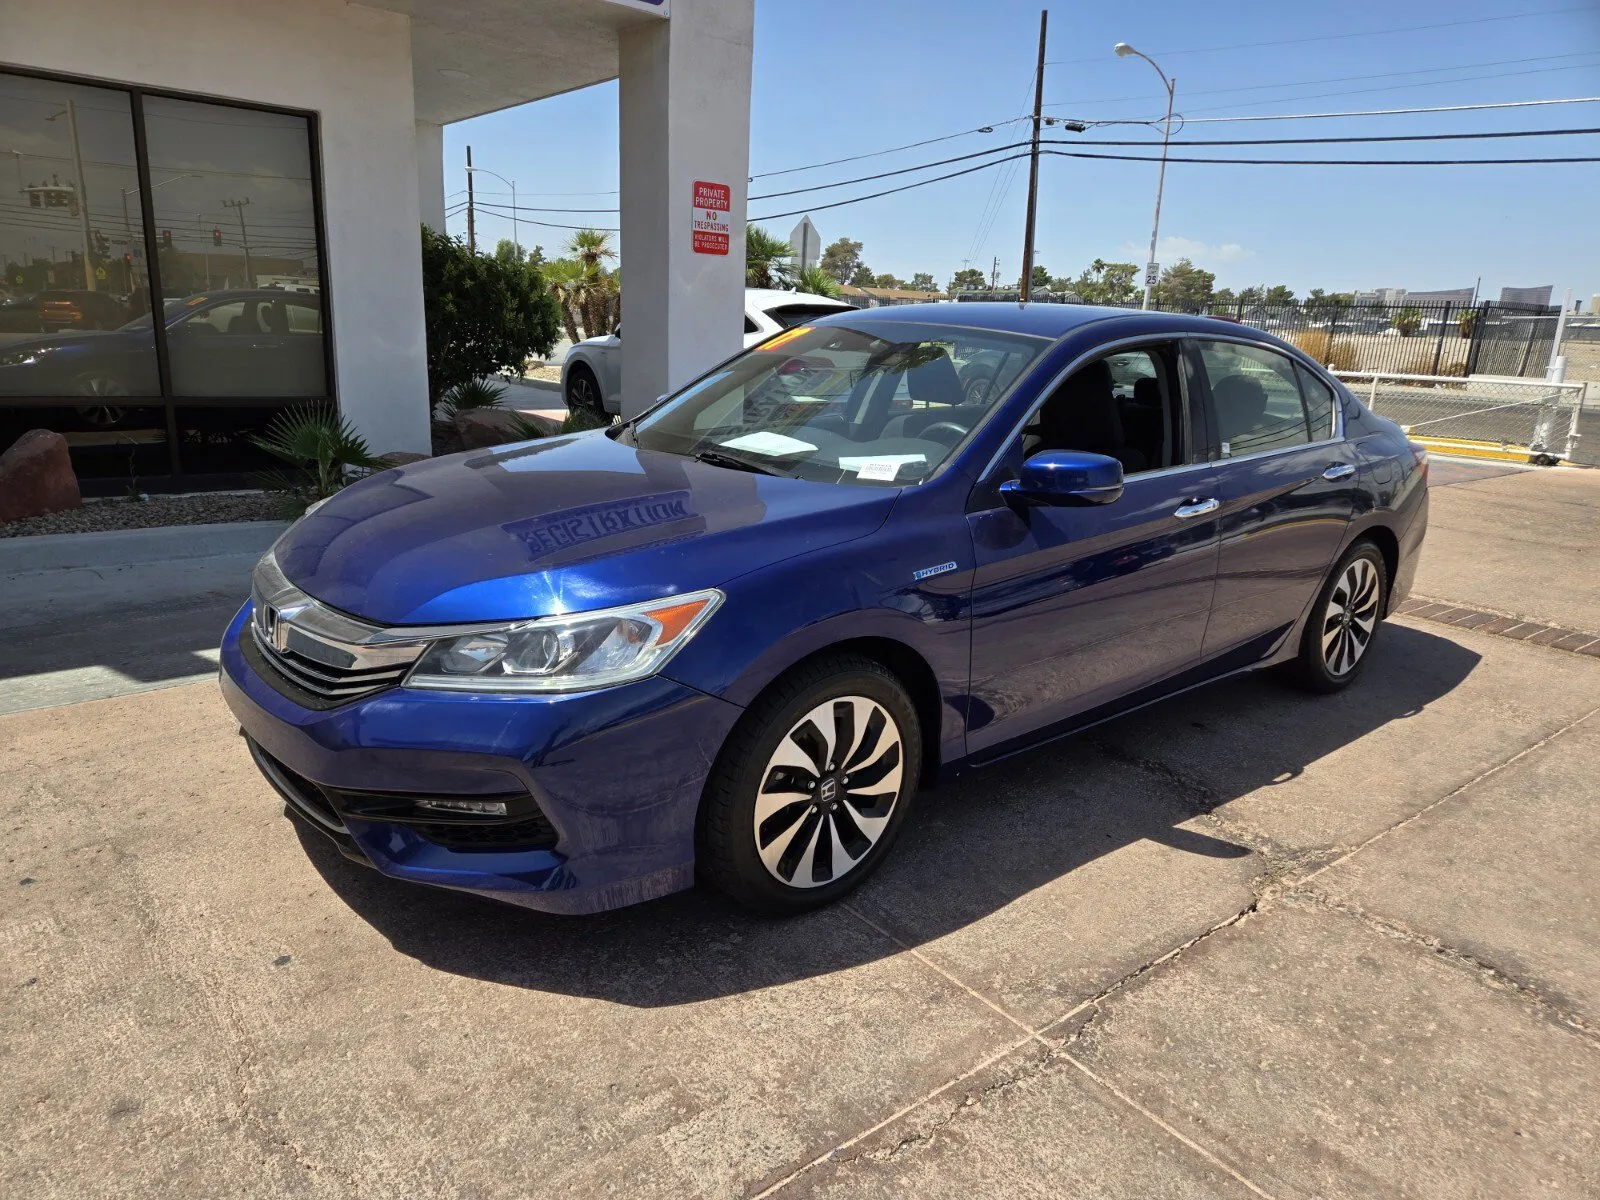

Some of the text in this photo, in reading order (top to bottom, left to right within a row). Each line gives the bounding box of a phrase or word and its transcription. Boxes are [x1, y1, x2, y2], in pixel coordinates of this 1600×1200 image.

[699, 187, 725, 199] PRIVATE
[695, 197, 728, 209] PROPERTY
[706, 211, 717, 221] NO
[694, 220, 729, 232] TRESPASSING
[1146, 275, 1156, 285] 25
[921, 562, 955, 577] HYBRID
